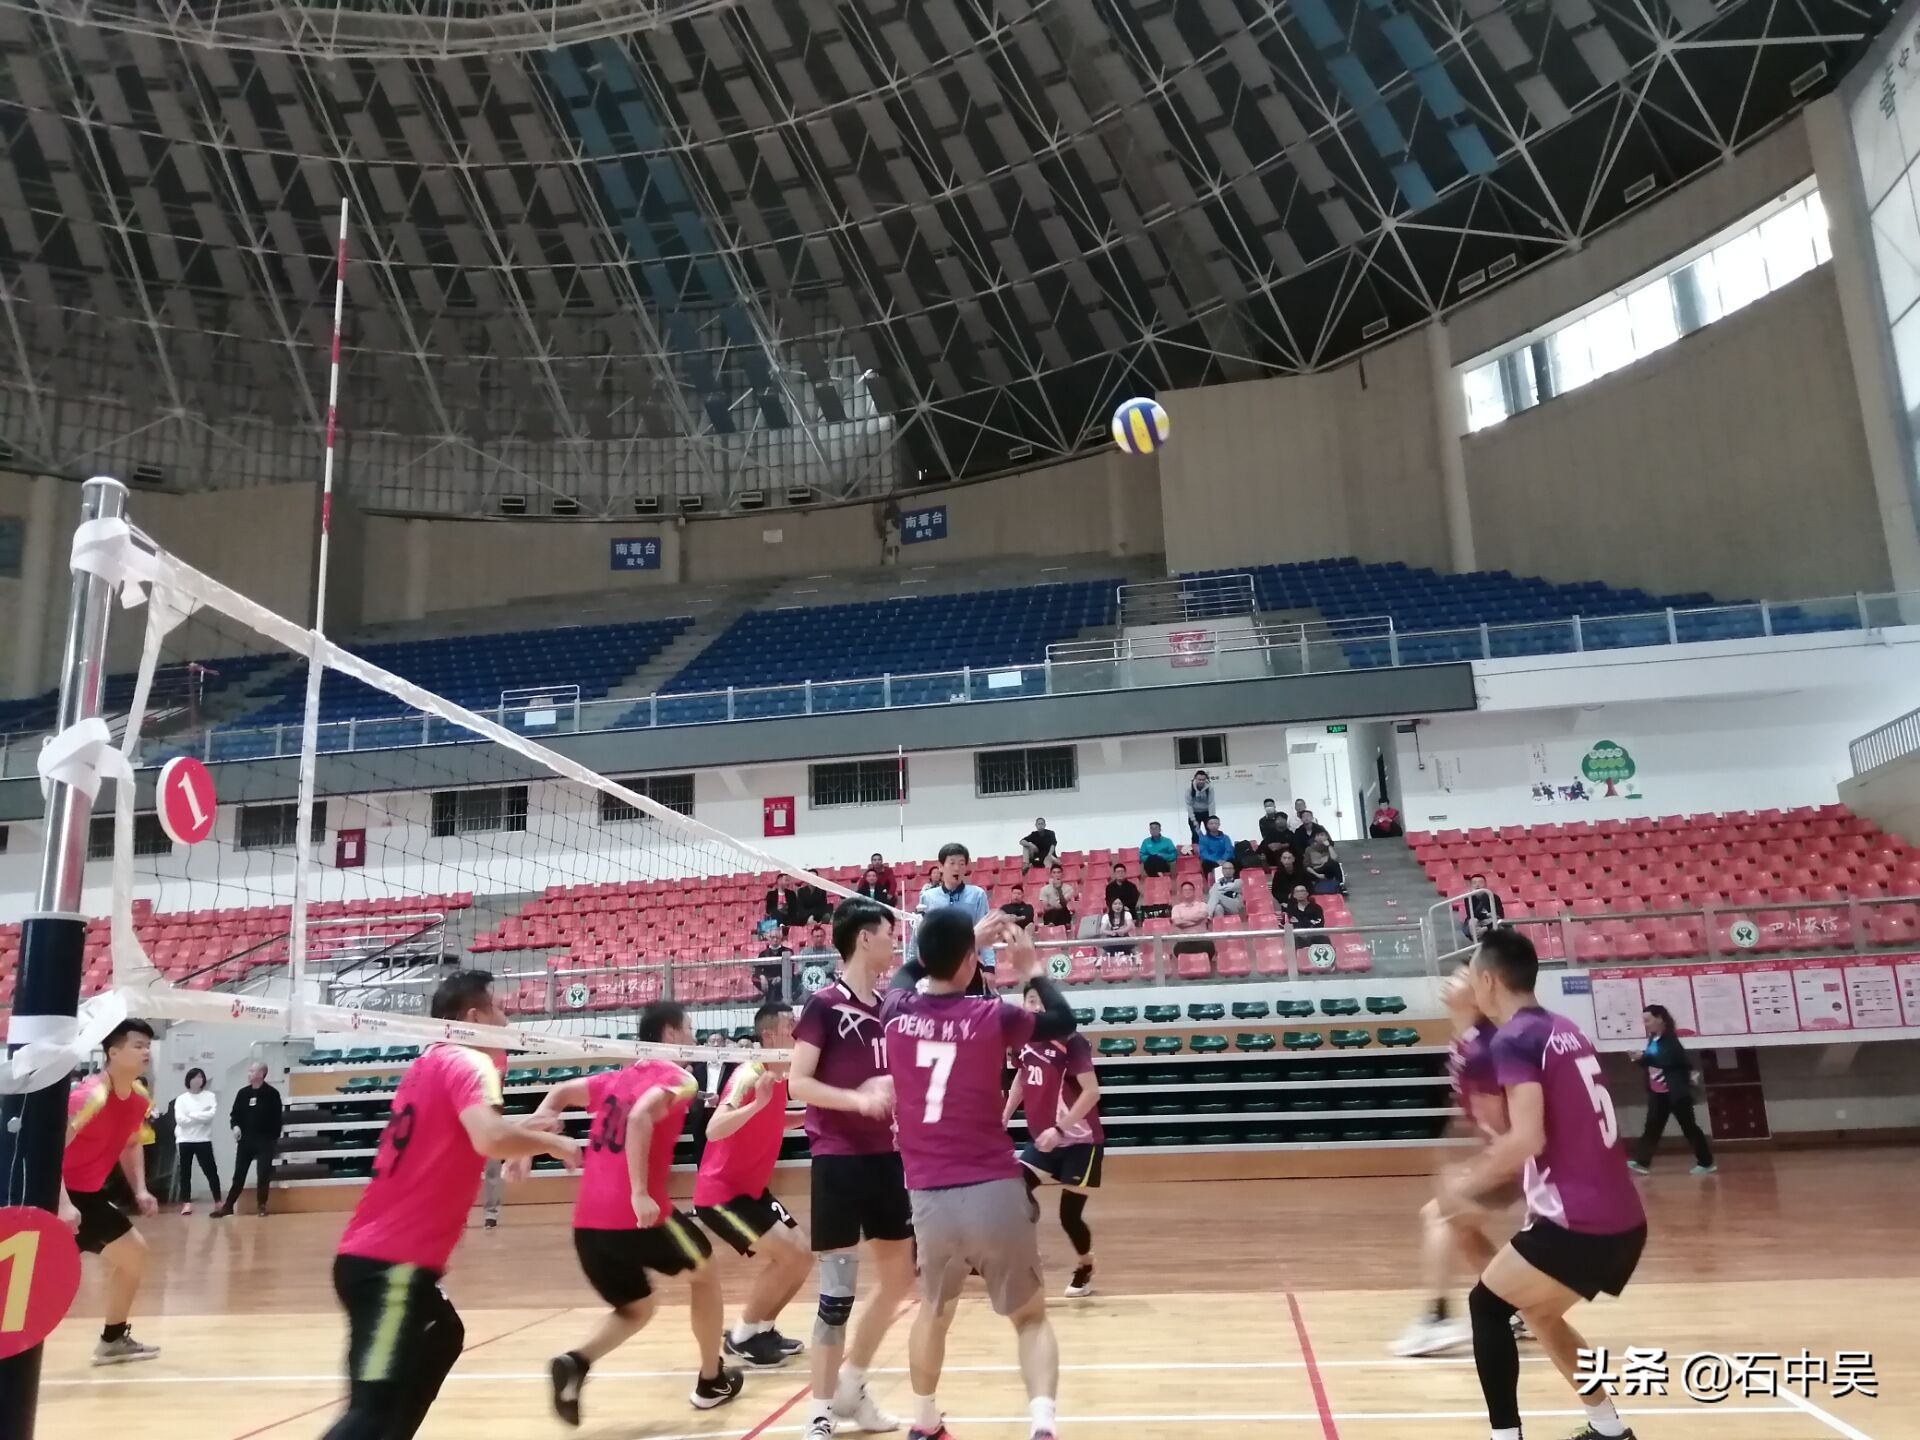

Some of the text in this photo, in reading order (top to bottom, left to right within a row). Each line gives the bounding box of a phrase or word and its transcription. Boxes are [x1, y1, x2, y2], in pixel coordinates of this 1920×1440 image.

[905, 511, 943, 528] 南看台
[615, 542, 656, 555] 南看台
[177, 770, 209, 831] 1
[898, 1013, 935, 1040] DENG
[915, 1040, 957, 1124] 7
[1027, 1064, 1043, 1086] 20
[1574, 1054, 1618, 1149] 5
[0, 1230, 40, 1332] 1
